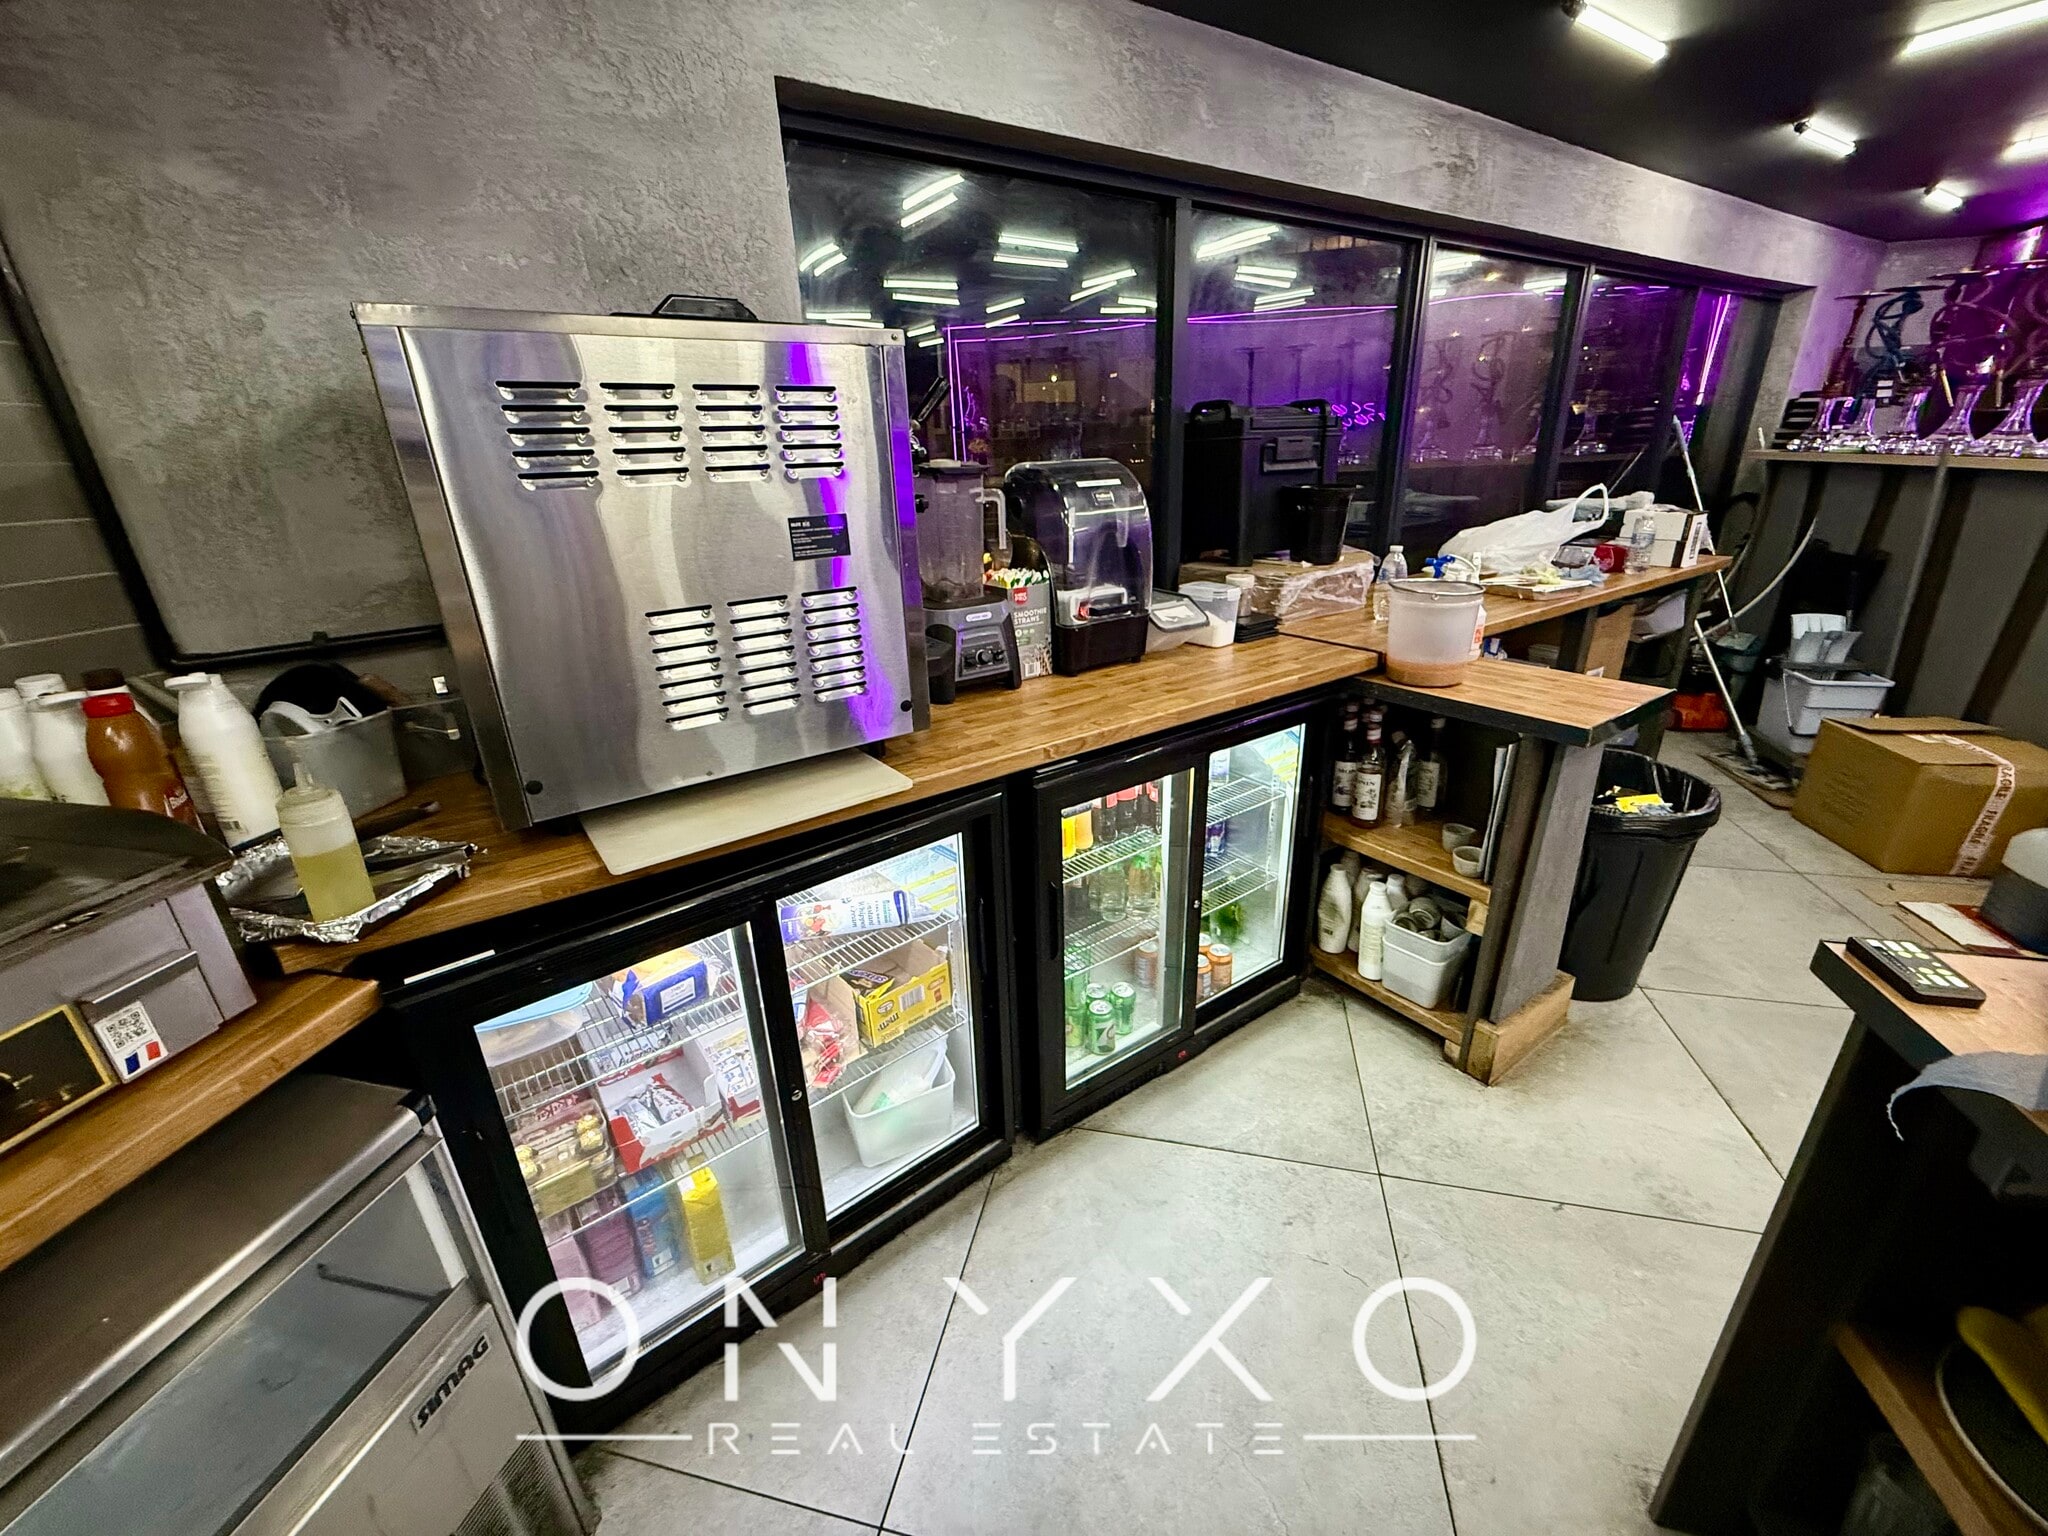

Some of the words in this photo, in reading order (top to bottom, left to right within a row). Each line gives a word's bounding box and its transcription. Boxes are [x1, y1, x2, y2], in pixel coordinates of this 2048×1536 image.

[1013, 607, 1047, 618] SMOOTHIE
[1014, 615, 1040, 625] STRAWS
[417, 1335, 489, 1428] SIMAG
